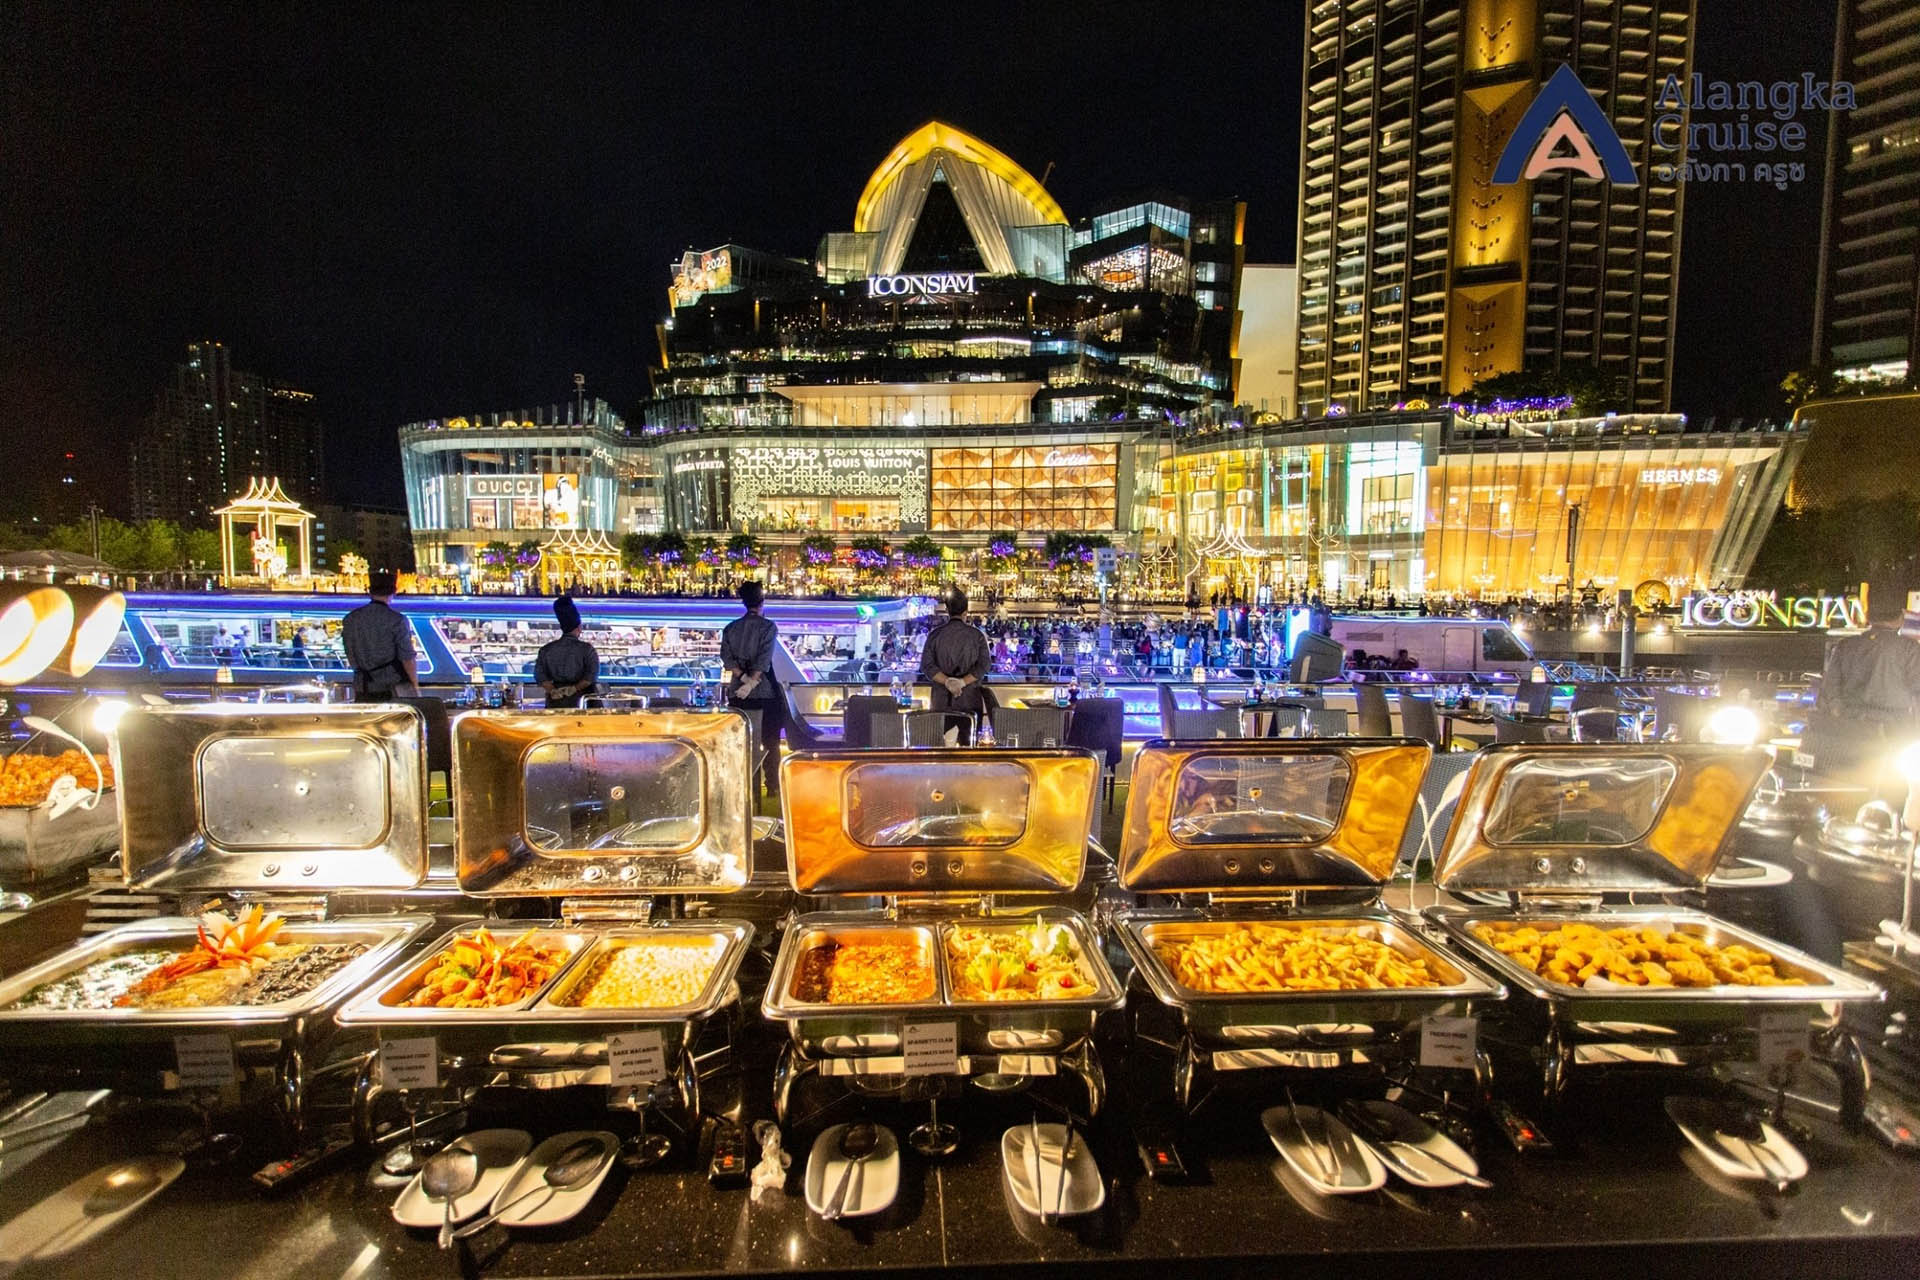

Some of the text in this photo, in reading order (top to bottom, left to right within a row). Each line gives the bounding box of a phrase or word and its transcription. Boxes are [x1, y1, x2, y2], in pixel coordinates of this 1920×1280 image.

[706, 256, 728, 272] 2022
[868, 272, 975, 296] ICONSIAM
[827, 458, 913, 468] LOUIS VUITTON
[477, 480, 533, 493] GUCCI
